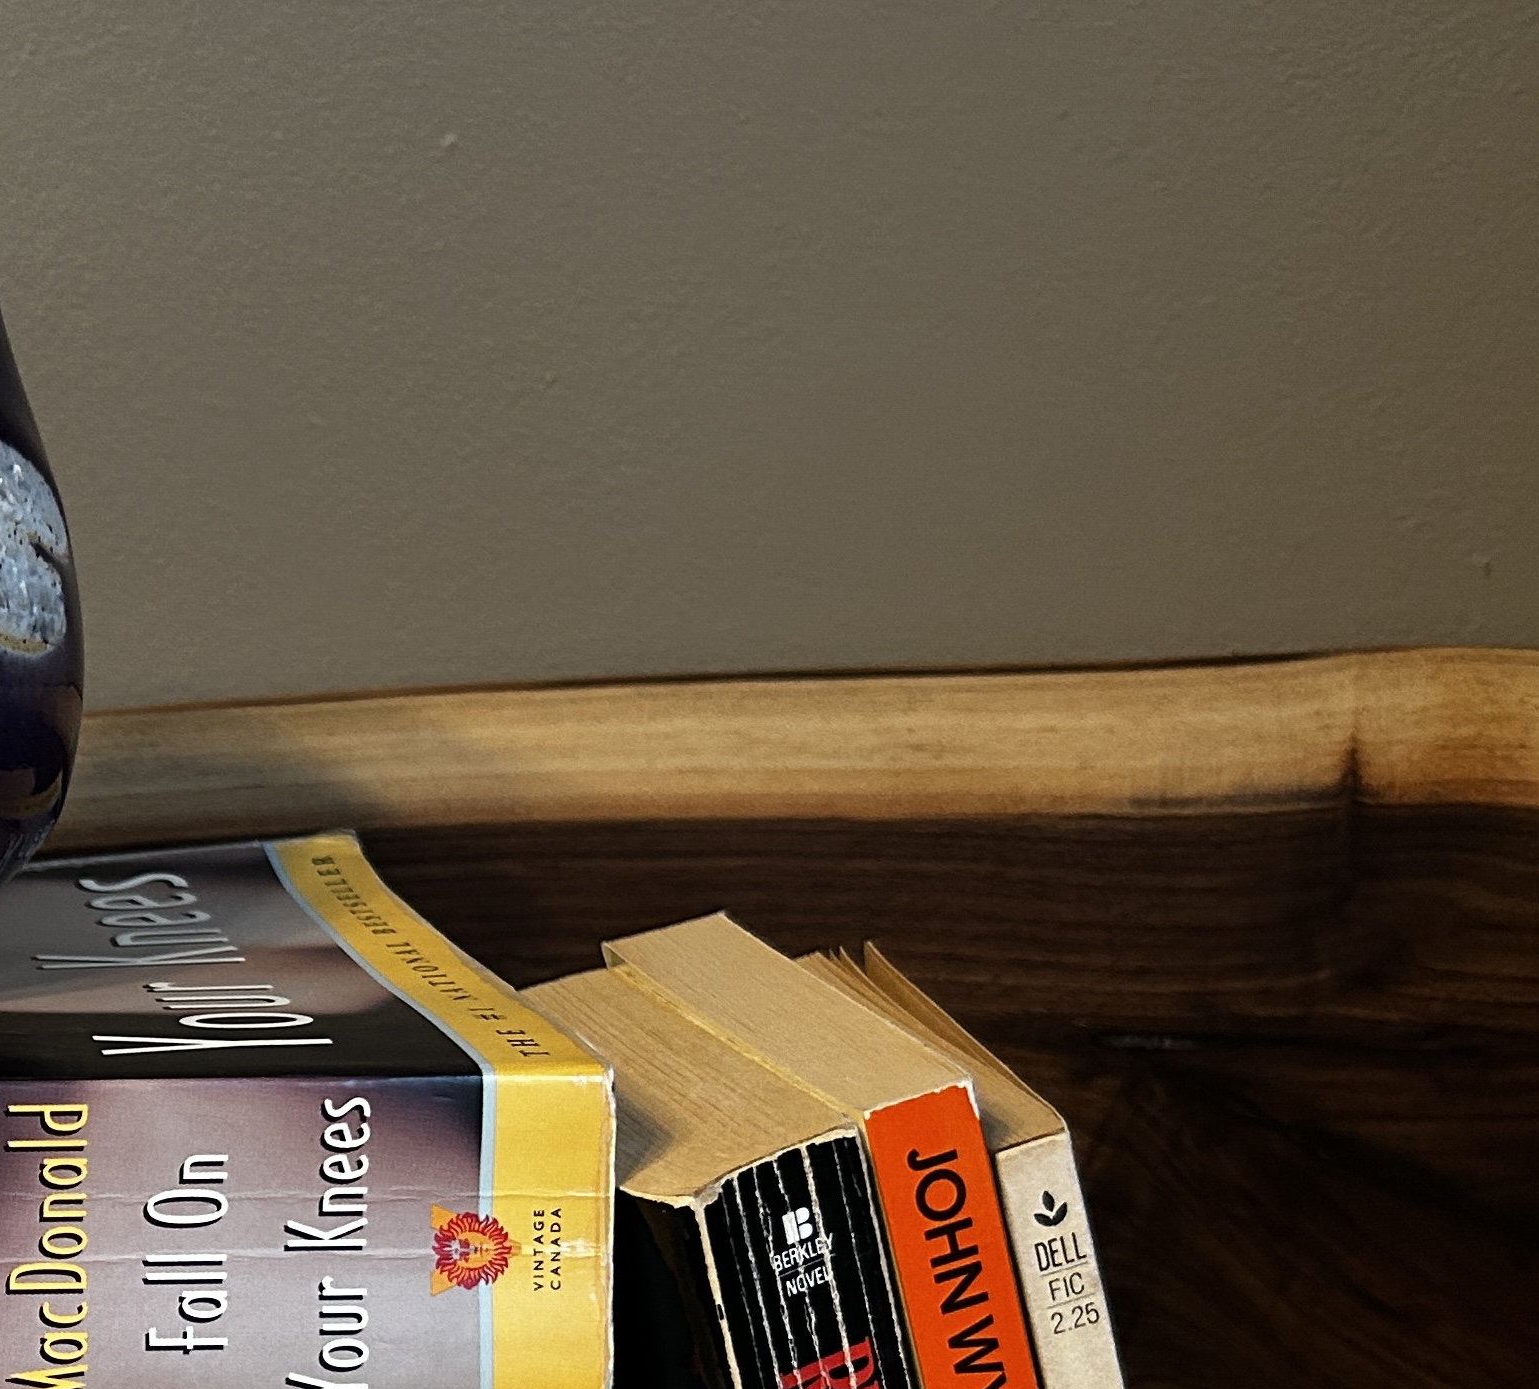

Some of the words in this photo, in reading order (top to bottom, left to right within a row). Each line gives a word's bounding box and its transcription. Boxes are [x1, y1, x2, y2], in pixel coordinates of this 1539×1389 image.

[33, 873, 247, 969] Knees
[311, 854, 398, 936] BESTSELLER
[386, 941, 479, 1001] NATIONAL
[92, 981, 334, 1056] Your
[496, 1028, 551, 1057] THE
[147, 1152, 229, 1227] On
[287, 1095, 372, 1255] Knees
[533, 1207, 546, 1291] VINTAGE
[550, 1205, 563, 1291] CANADA
[774, 1233, 833, 1271] BERKLEY
[907, 1149, 990, 1317] JOHN
[1036, 1236, 1088, 1274] DELL
[145, 1253, 229, 1354] Fall
[786, 1266, 830, 1297] NOVEL
[1049, 1273, 1087, 1301] FIC
[1051, 1302, 1100, 1335] 2.25
